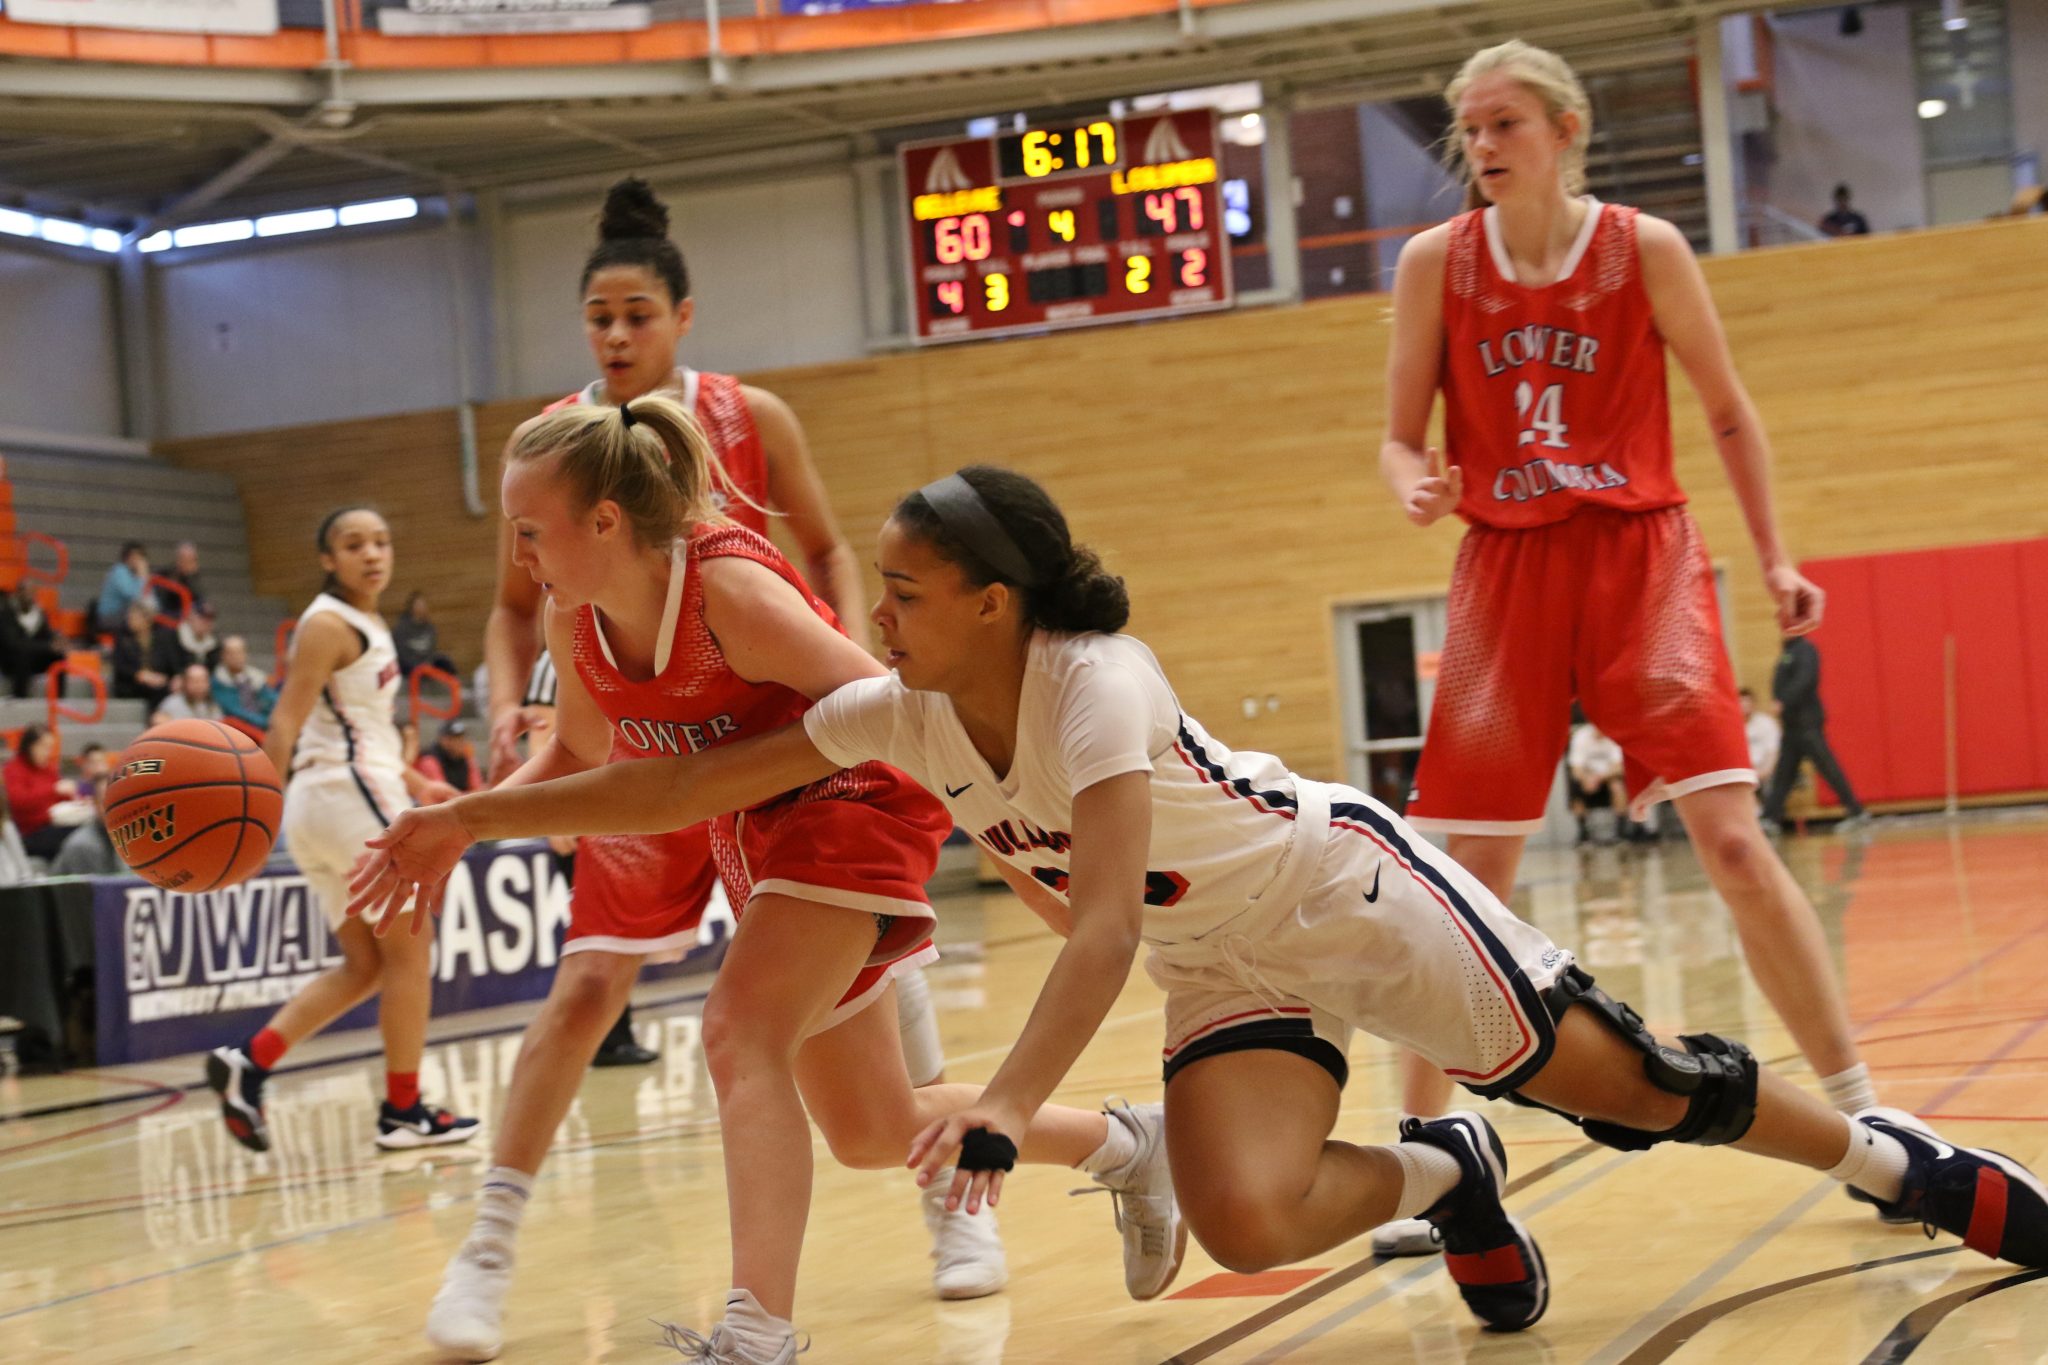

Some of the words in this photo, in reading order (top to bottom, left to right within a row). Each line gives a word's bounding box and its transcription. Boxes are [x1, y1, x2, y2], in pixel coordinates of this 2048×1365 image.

[1021, 121, 1117, 178] 6:17
[1048, 209, 1076, 242] 4
[1144, 186, 1204, 234] 47
[934, 213, 992, 265] 60
[1125, 255, 1152, 294] 2
[1180, 248, 1207, 287] 2
[937, 280, 964, 313] 4
[985, 272, 1010, 311] 3
[1478, 323, 1600, 378] LOWER
[618, 712, 742, 756] OWER
[108, 759, 166, 785] ELIT
[111, 803, 176, 858] Bade
